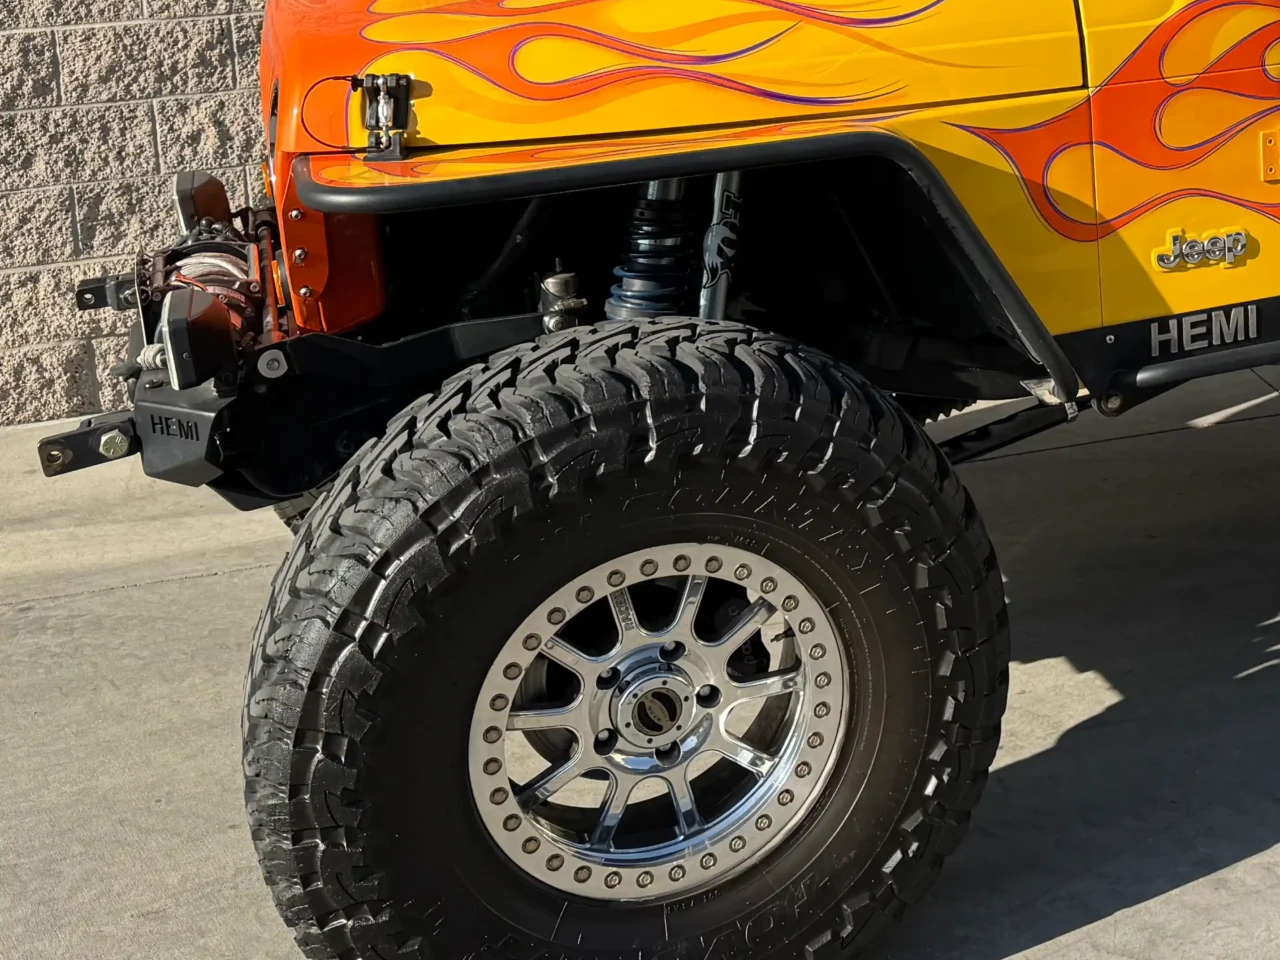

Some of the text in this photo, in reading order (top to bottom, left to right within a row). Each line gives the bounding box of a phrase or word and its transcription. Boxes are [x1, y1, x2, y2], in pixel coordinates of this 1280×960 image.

[1156, 231, 1247, 269] Jeep
[1150, 304, 1258, 357] HEMI
[150, 414, 200, 441] HEMI
